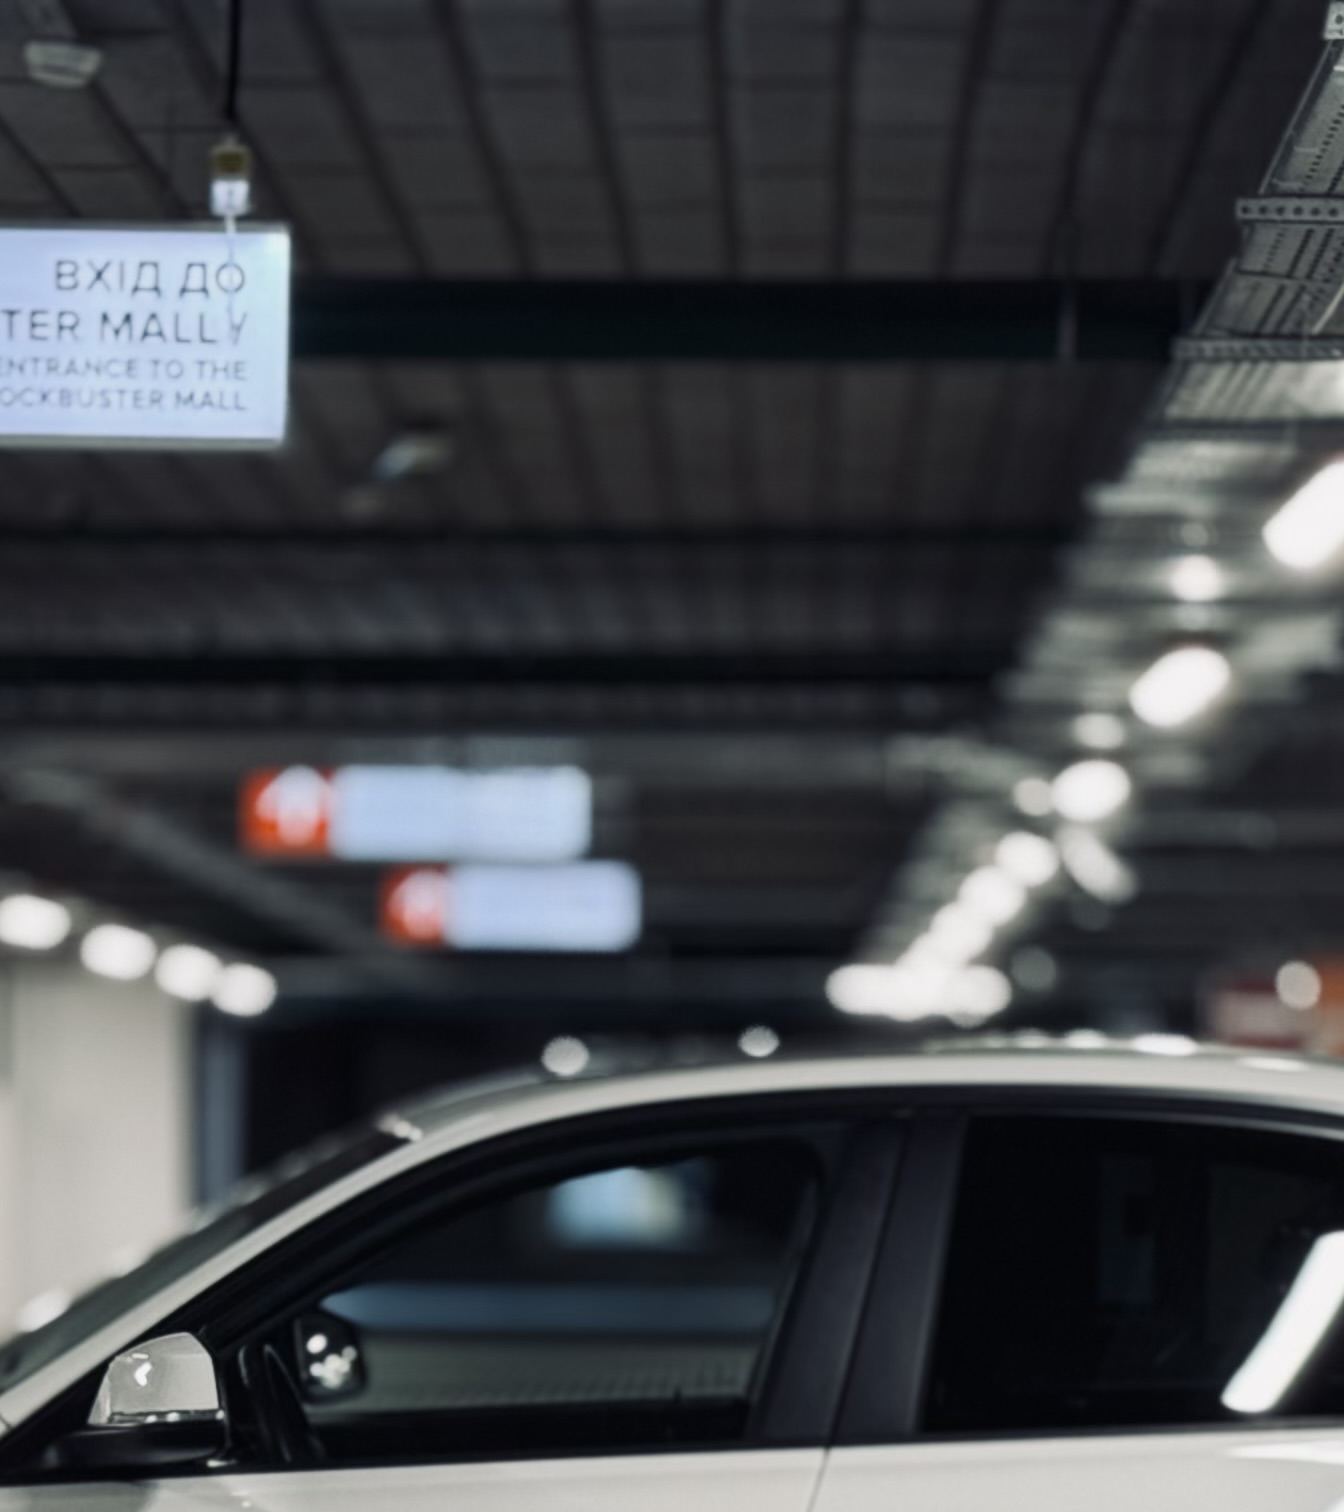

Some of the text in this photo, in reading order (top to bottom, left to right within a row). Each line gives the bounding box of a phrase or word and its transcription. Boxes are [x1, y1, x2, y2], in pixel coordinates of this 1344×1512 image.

[54, 259, 245, 298] ВХІД ДО
[151, 358, 185, 379] TO
[194, 359, 248, 381] THE
[174, 389, 248, 412] MALL
